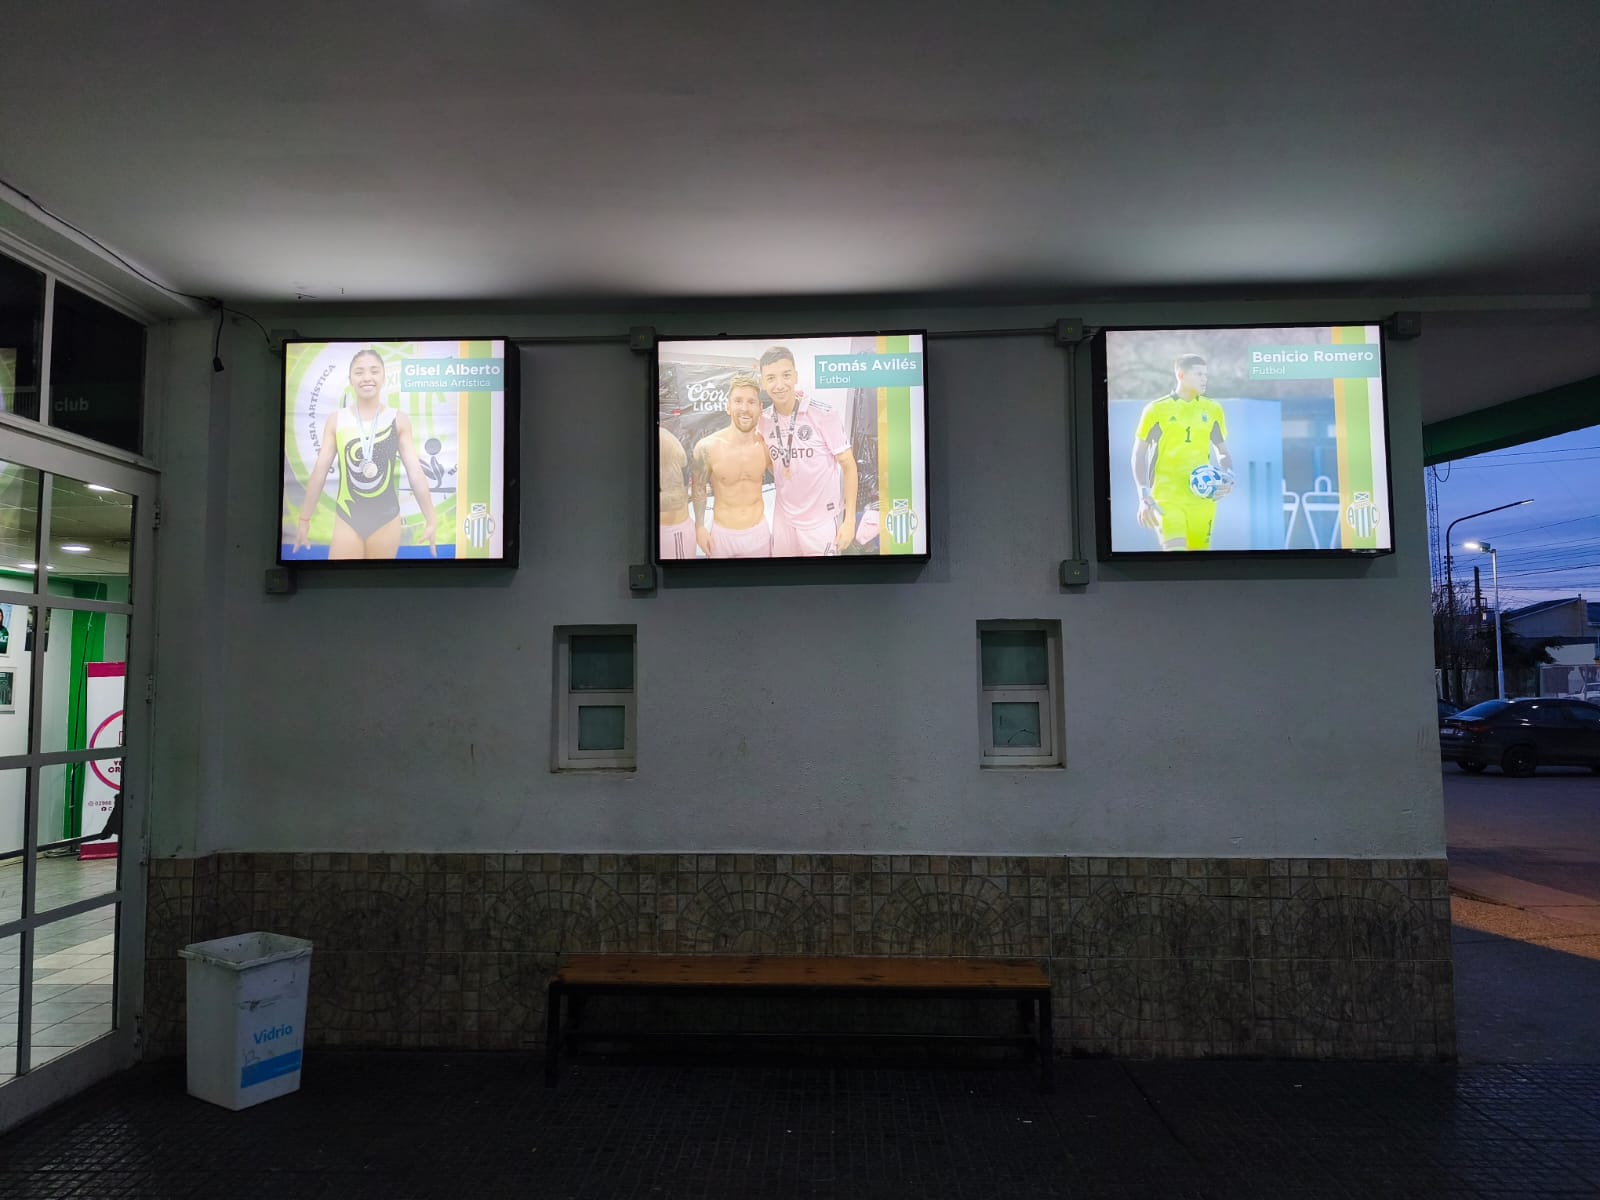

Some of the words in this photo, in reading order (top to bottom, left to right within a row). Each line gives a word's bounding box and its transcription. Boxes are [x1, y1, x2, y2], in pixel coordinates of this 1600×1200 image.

[1252, 351, 1308, 363] Benicio
[1314, 351, 1373, 362] Romero
[404, 364, 441, 376] Gisel
[444, 363, 501, 376] Alberto
[818, 359, 867, 372] Tomás
[871, 358, 917, 371] Avilés
[404, 379, 448, 388] Gimnasia
[54, 397, 89, 412] club
[1184, 426, 1192, 443] 1
[253, 1024, 293, 1045] Vidrio
